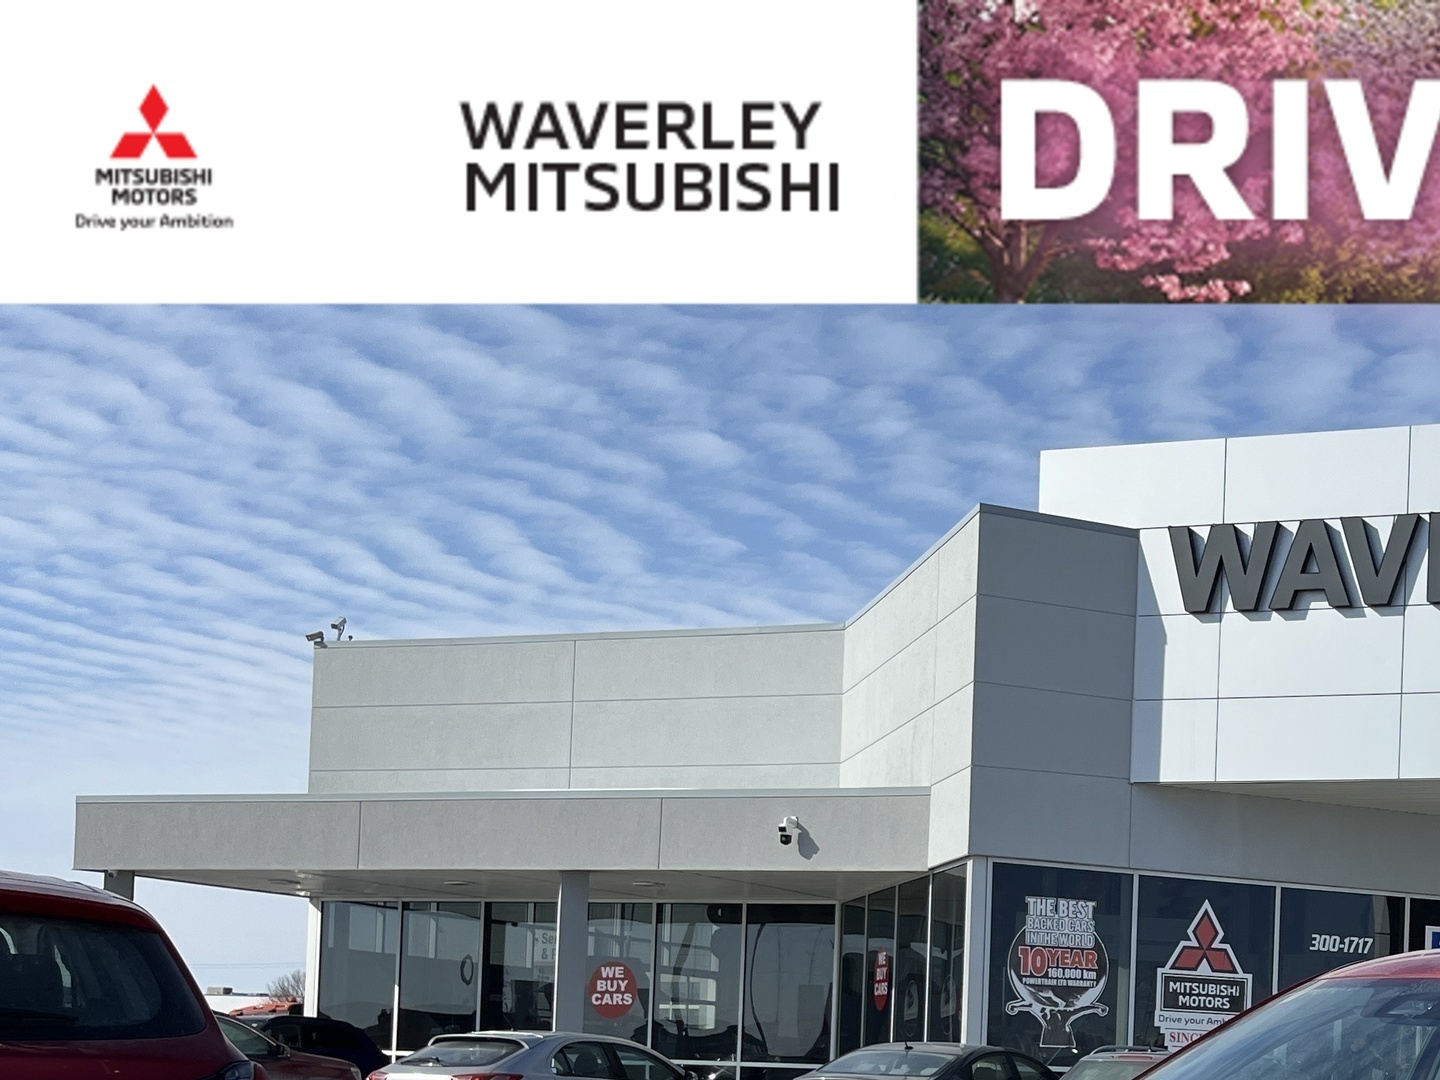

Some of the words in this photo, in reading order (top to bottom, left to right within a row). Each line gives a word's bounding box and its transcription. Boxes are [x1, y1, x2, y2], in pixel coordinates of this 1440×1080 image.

[1025, 896, 1057, 918] THE
[1058, 898, 1097, 920] BEST
[1027, 917, 1066, 932] BACKED
[1068, 919, 1095, 933] CARS
[1059, 932, 1094, 948] WORLD
[1309, 934, 1373, 954] 300-1717
[1018, 946, 1048, 976] 10
[1046, 948, 1098, 969] YEAR
[601, 966, 625, 978] WE
[596, 979, 629, 992] BUY
[1169, 981, 1240, 997] MITSUBISHI
[591, 993, 633, 1006] CARS
[1178, 995, 1230, 1009] MOTORS
[1159, 1014, 1182, 1023] Drive
[1184, 1016, 1204, 1026] your
